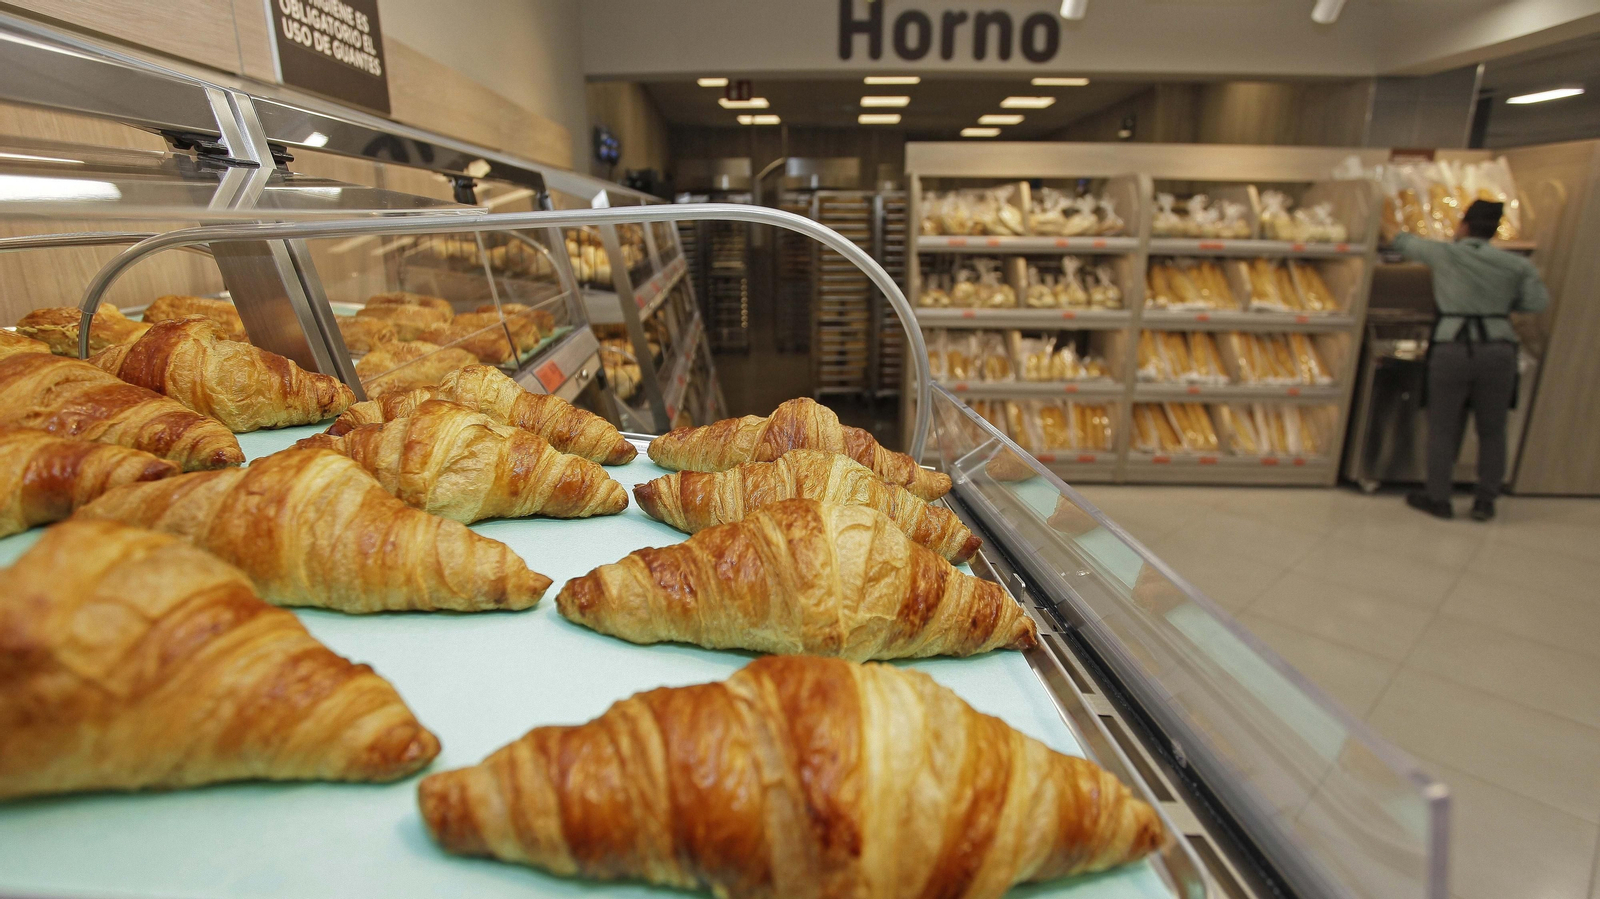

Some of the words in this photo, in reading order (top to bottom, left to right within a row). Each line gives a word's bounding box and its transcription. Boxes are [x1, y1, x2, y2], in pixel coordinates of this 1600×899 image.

[279, 0, 362, 48] OBLIGATORIO
[362, 34, 377, 55] EL
[308, 0, 355, 27] GIENE
[354, 10, 370, 34] ES
[838, 0, 1061, 63] Horno
[281, 16, 313, 47] USO
[313, 30, 333, 56] DE
[332, 39, 382, 76] GUANTES
